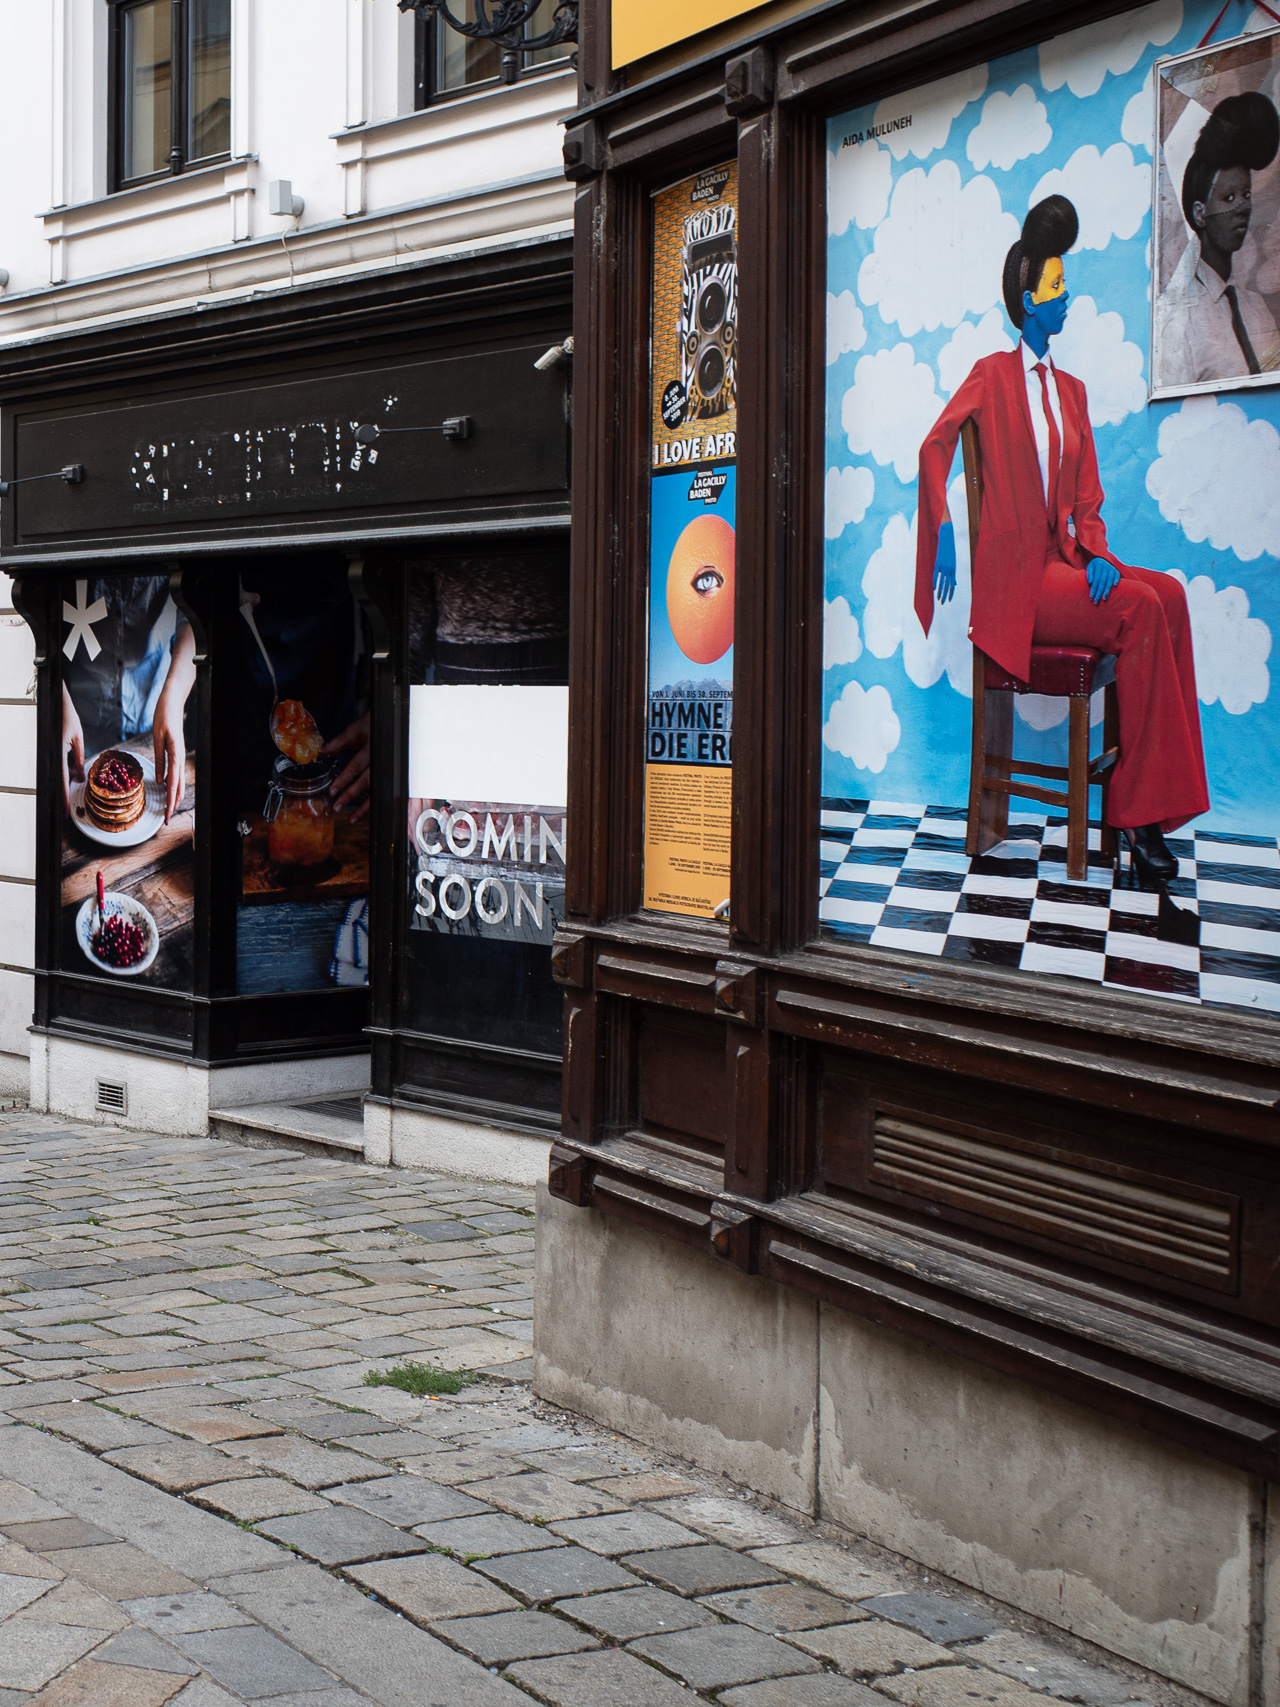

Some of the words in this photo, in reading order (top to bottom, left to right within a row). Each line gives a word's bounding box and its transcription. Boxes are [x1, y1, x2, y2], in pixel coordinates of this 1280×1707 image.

[842, 132, 864, 148] AIDA
[866, 115, 912, 141] MULUNEH
[692, 186, 714, 201] BADEN
[696, 179, 705, 190] LA
[705, 170, 729, 186] GACILLY
[654, 444, 660, 465] I
[663, 437, 701, 464] LOVE
[689, 487, 712, 499] BADEN
[694, 479, 703, 489] LA
[702, 475, 727, 487] GACILLY
[671, 690, 684, 699] JUNI
[686, 690, 696, 699] BIS
[651, 701, 724, 729] HYMNE
[650, 731, 688, 758] DIE
[415, 808, 567, 865] COMIN
[414, 870, 544, 930] SOON
